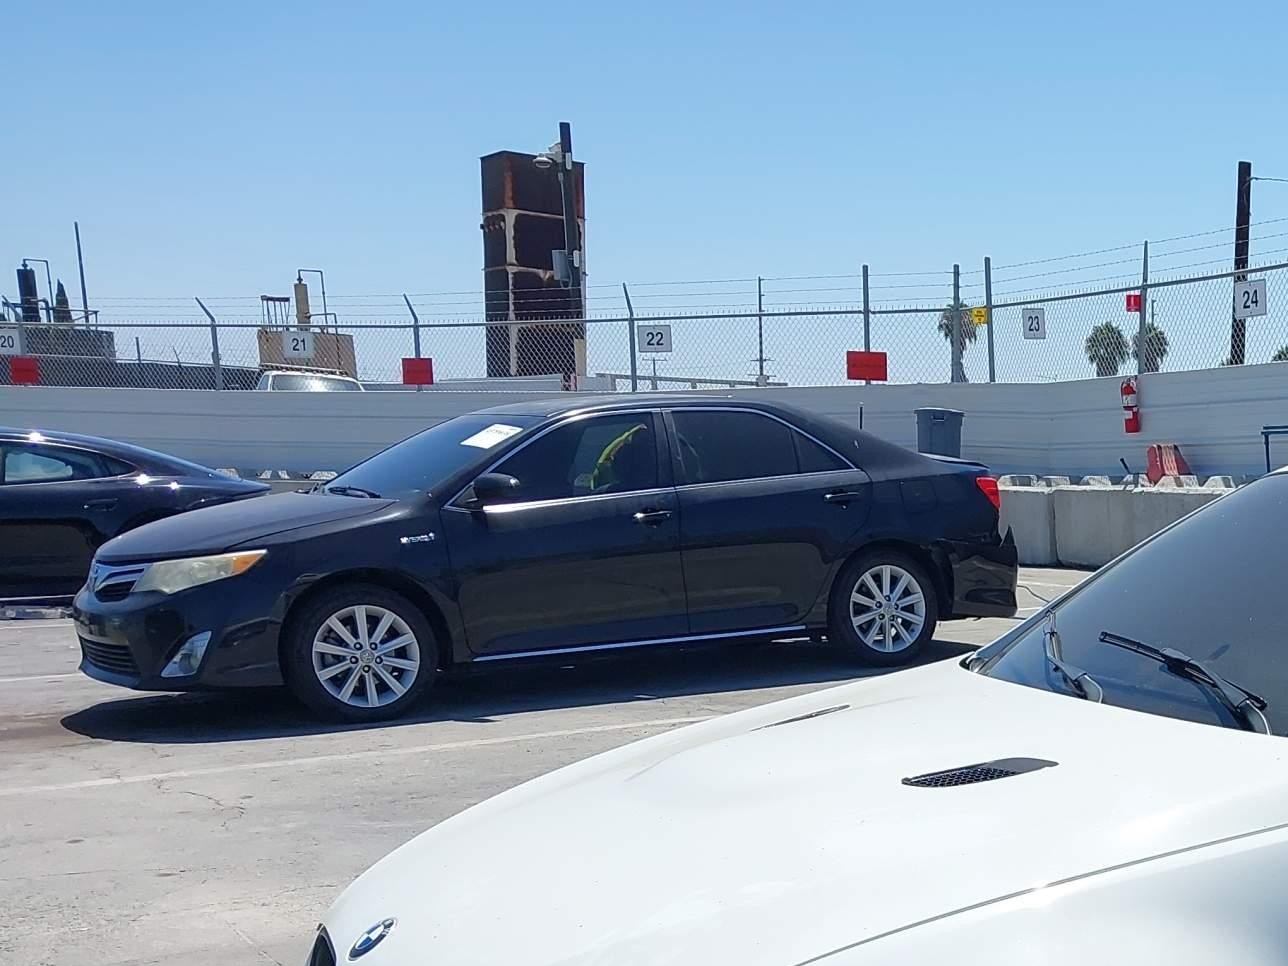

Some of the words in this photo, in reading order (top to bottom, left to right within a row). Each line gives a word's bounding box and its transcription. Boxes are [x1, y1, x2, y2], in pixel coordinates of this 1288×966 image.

[1242, 289, 1259, 309] 24
[1027, 315, 1040, 332] 23
[0, 335, 14, 348] 20
[291, 337, 306, 351] 21
[646, 331, 665, 346] 22
